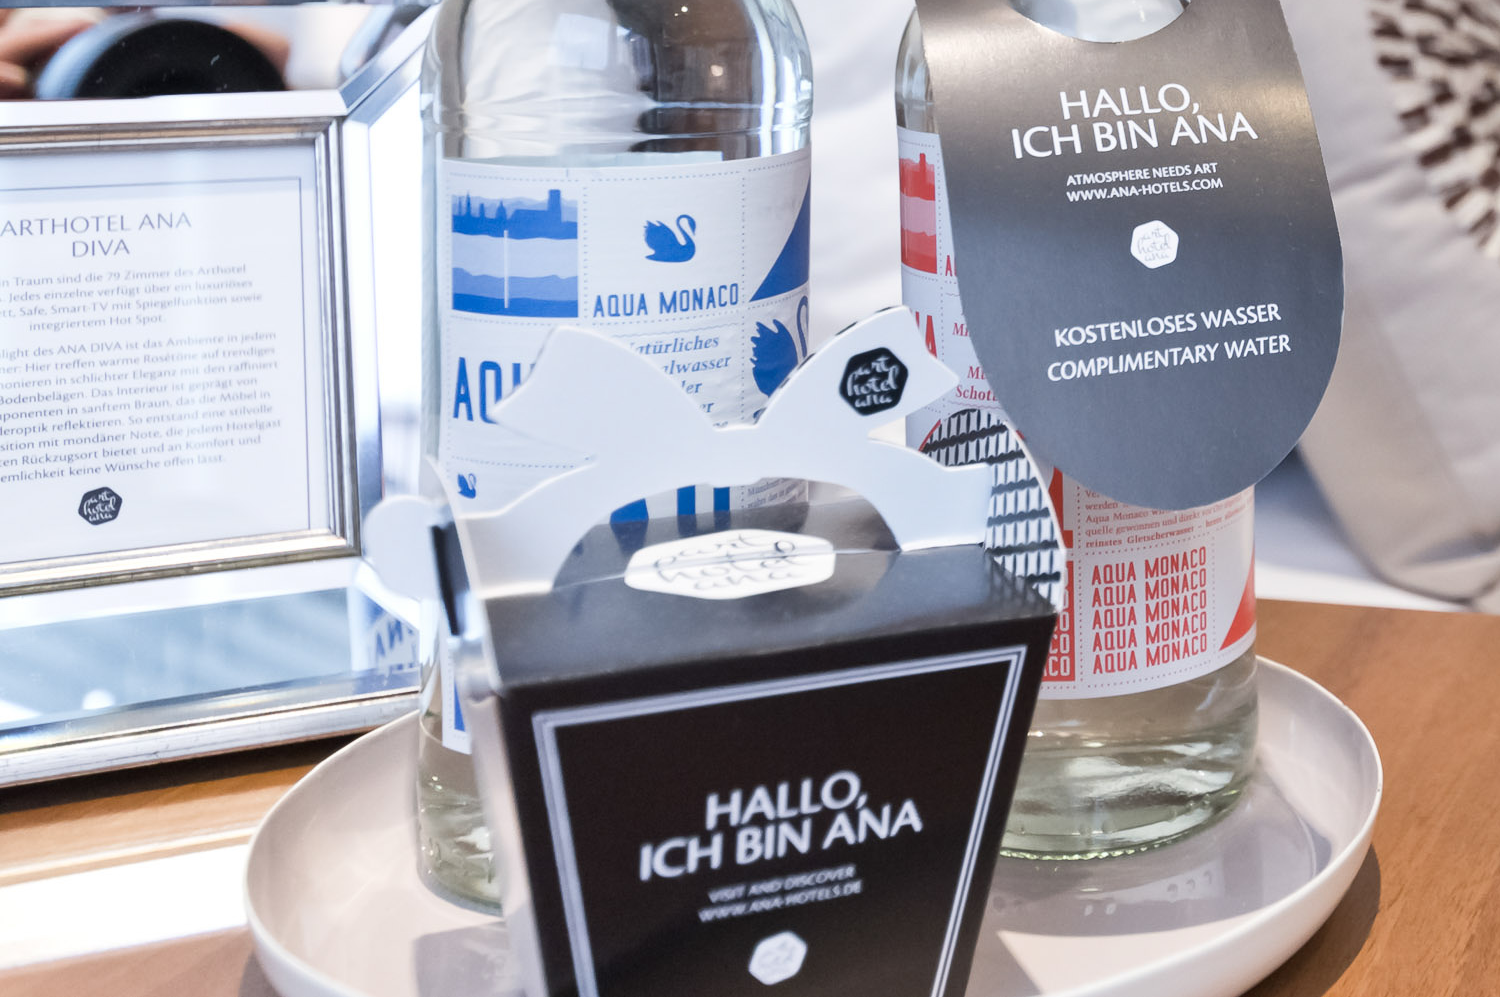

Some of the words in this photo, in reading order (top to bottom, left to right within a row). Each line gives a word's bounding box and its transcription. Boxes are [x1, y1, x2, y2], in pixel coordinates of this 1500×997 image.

[1058, 83, 1200, 120] HALLO,
[1011, 124, 1083, 159] ICH
[1092, 117, 1160, 153] BIN
[1170, 111, 1259, 146] ANA
[1065, 167, 1151, 187] ATMOSPHERE
[1152, 164, 1193, 180] NEEDS
[1193, 162, 1219, 176] ART
[1066, 177, 1224, 202] WWW.ANA-HOTELS.COM
[0, 214, 132, 237] ARTHOTEL
[138, 211, 193, 231] ANA
[71, 238, 131, 258] DIVA
[14, 275, 54, 288] Traum
[56, 273, 82, 285] sind
[85, 272, 104, 284] die
[124, 268, 171, 281] Zimmer
[197, 263, 246, 276] Arthotel
[8, 290, 41, 303] Jedes
[44, 288, 95, 301] einzelne
[97, 284, 140, 299] verfügt
[144, 282, 171, 294] über
[111, 300, 132, 310] mit
[593, 292, 649, 319] AQUA
[659, 282, 740, 314] MONACO
[29, 318, 106, 332] integriertem
[109, 315, 132, 326] Hot
[1054, 312, 1198, 347] KOSTENLOSES
[1200, 303, 1282, 329] WASSER
[0, 348, 29, 361] light
[33, 346, 54, 357] des
[57, 344, 88, 355] ANA
[90, 341, 123, 353] DIVA
[125, 340, 139, 350] ist
[142, 338, 163, 350] das
[25, 362, 51, 374] Hier
[55, 359, 96, 371] treffen
[99, 357, 141, 367] warme
[201, 349, 220, 359] auf
[1047, 342, 1220, 382] COMPLIMENTARY
[1223, 334, 1292, 360] WATER
[55, 376, 67, 385] in
[70, 371, 129, 385] schlichter
[132, 368, 177, 381] Eleganz
[91, 387, 114, 398] Das
[117, 383, 168, 397] Interieur
[67, 406, 78, 415] in
[81, 401, 131, 414] sanftem
[128, 414, 143, 425] So
[0, 440, 35, 452] sition
[38, 438, 59, 449] mit
[63, 432, 126, 446] mondäner
[22, 450, 98, 465] Rückzugsort
[102, 446, 137, 458] bietet
[141, 443, 165, 455] und
[167, 443, 182, 453] an
[0, 468, 65, 483] emlichkeit
[69, 465, 102, 477] keine
[104, 459, 161, 474] Wünsche
[163, 456, 194, 468] offen
[1091, 561, 1137, 586] AQUA
[1144, 546, 1207, 580] MONACO
[1091, 583, 1137, 608] AQUA
[1144, 568, 1207, 602] MONACO
[1092, 605, 1137, 630] AQUA
[1145, 589, 1207, 624] MONACO
[1092, 628, 1138, 653] AQUA
[1145, 611, 1207, 646] MONACO
[1092, 649, 1138, 675] AQUA
[1145, 633, 1207, 668] MONACO
[705, 769, 868, 831] HALLO,
[639, 832, 723, 881] ICH
[735, 818, 812, 866] BIN
[822, 798, 923, 850] ANA
[784, 864, 857, 891] DISCOVER
